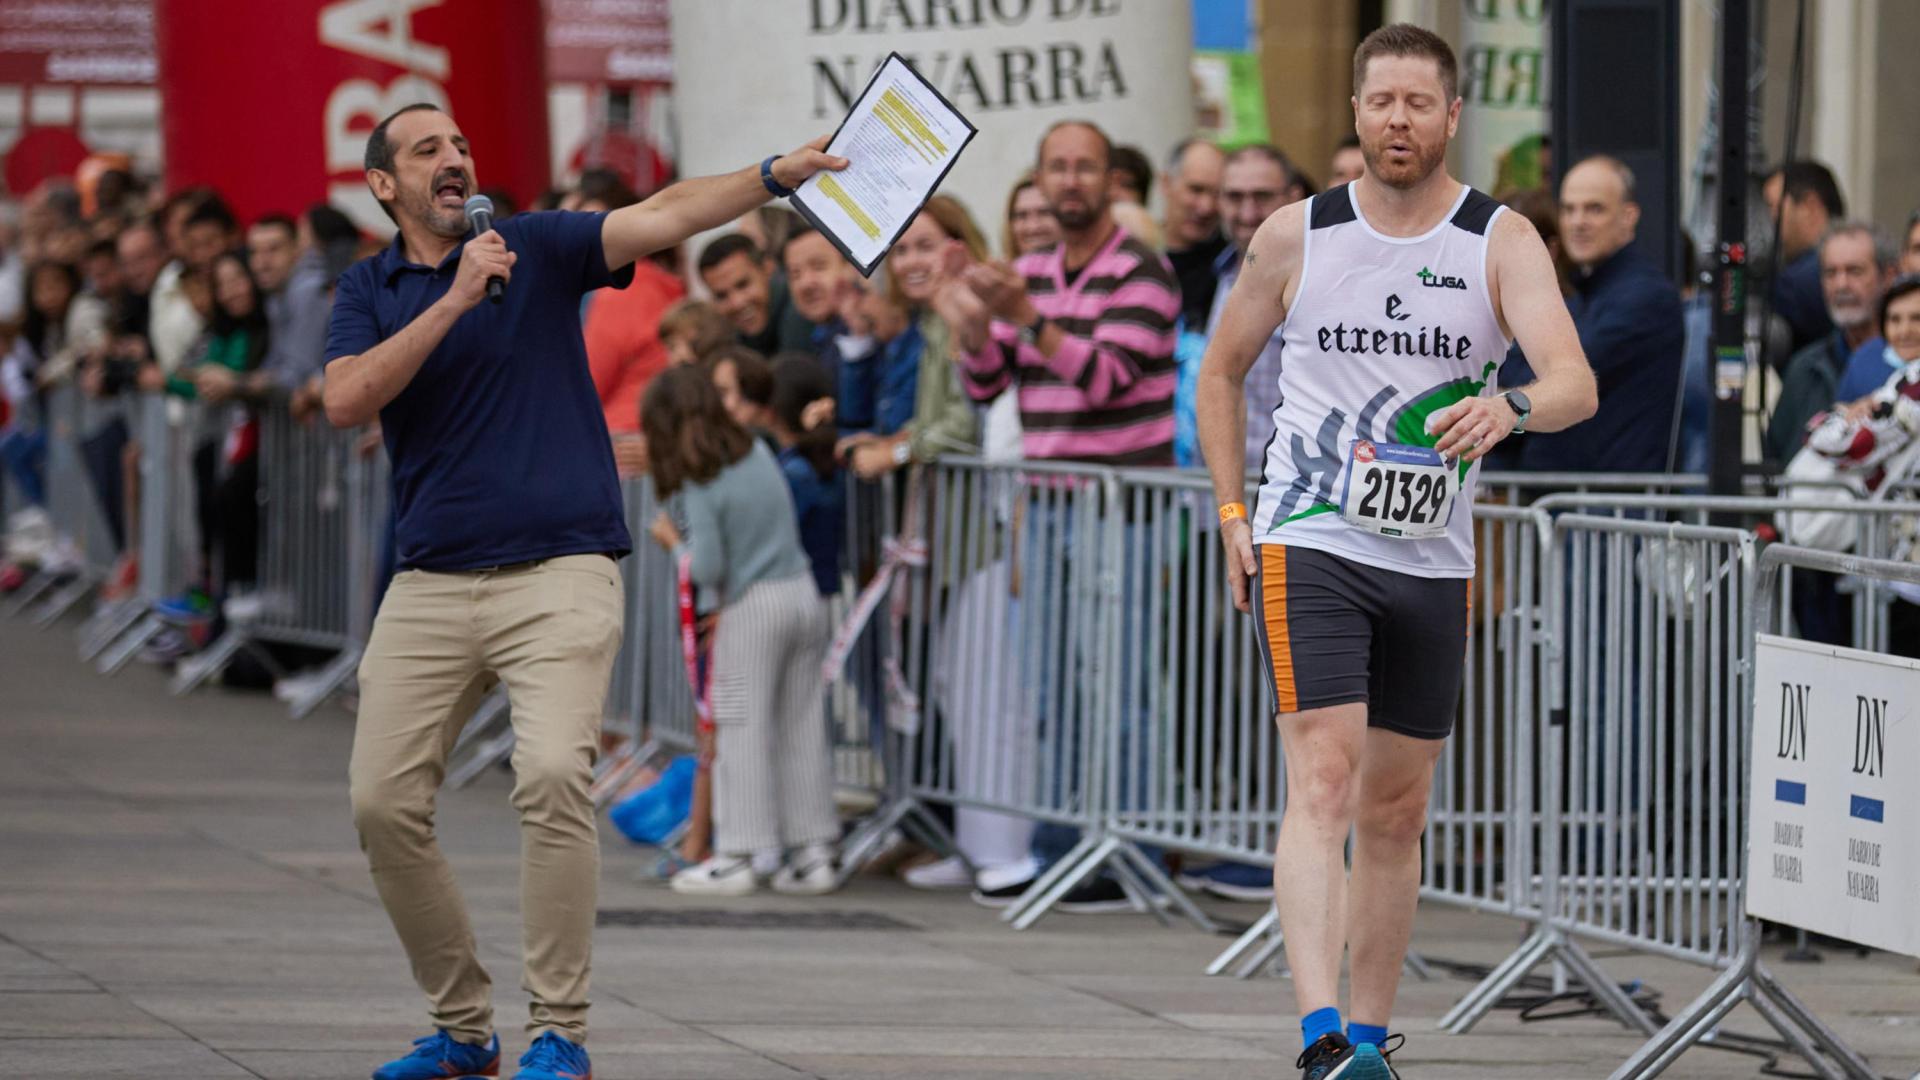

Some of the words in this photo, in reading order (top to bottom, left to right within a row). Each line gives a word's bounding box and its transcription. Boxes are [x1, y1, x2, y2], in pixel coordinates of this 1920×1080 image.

[806, 39, 1128, 120] NVARRA
[1423, 274, 1468, 290] LUGA
[1358, 467, 1447, 524] 21329
[1777, 682, 1811, 762] DN
[1852, 695, 1888, 778] DN
[1871, 842, 1881, 867] DE
[1846, 869, 1880, 903] NAVARRA
